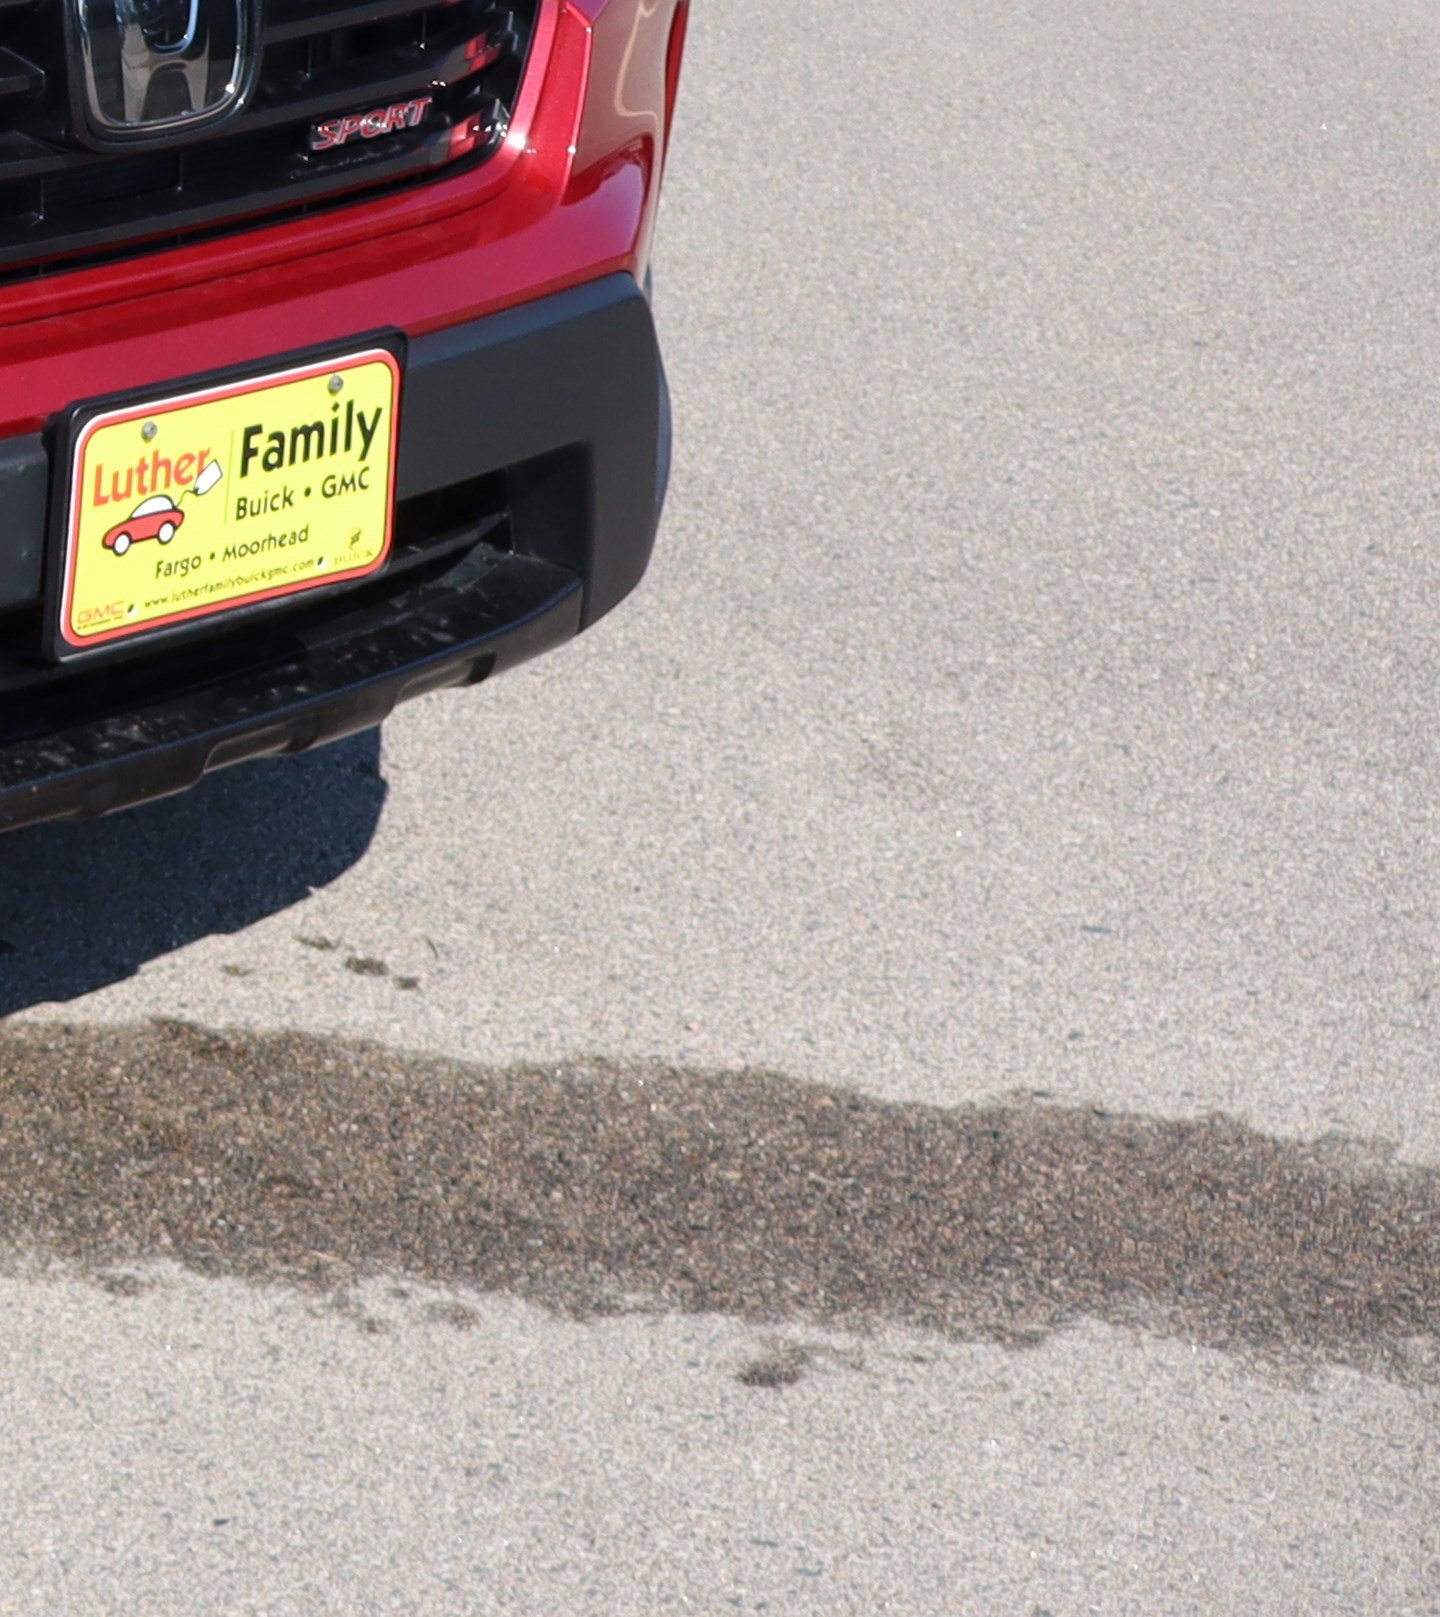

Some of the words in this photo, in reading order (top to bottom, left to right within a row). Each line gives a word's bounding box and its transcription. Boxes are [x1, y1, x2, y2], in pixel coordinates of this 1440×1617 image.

[311, 97, 433, 151] SPORT
[240, 399, 383, 478] Family
[92, 446, 211, 507] Luther
[235, 486, 294, 522] Buick
[321, 465, 371, 499] GMC
[154, 553, 202, 580] Fargo
[222, 523, 310, 563] Moorhead
